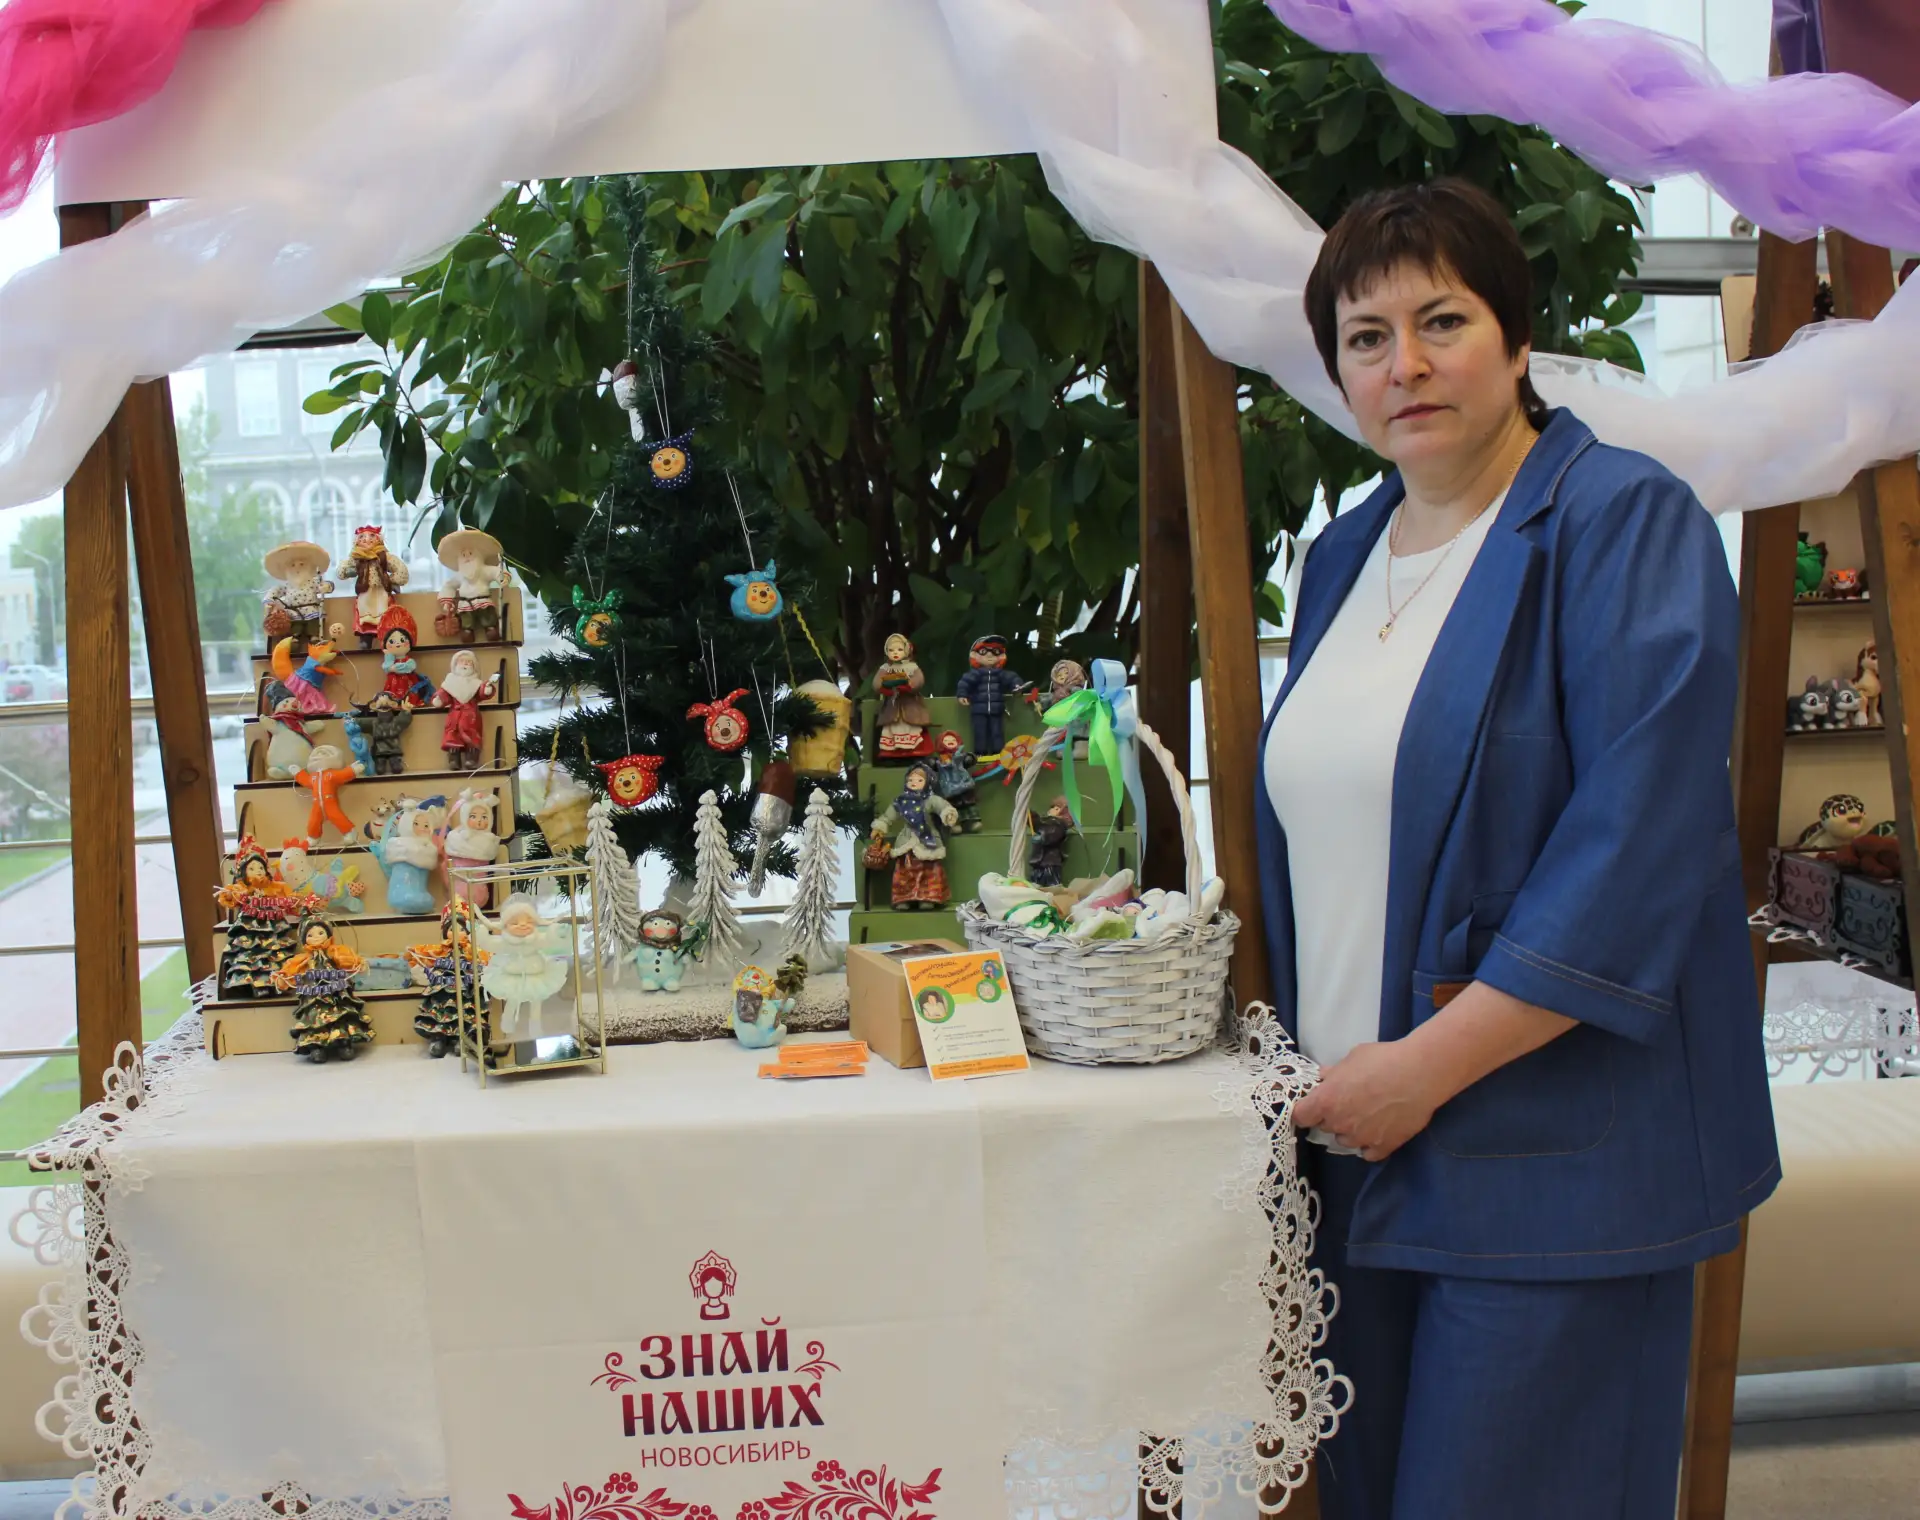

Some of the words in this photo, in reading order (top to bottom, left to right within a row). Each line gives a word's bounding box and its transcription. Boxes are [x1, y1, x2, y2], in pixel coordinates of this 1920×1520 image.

[639, 1316, 789, 1379] ЗНАЙ
[621, 1382, 824, 1437] НАШИХ
[641, 1440, 811, 1468] НОВОСИБИРЬ
